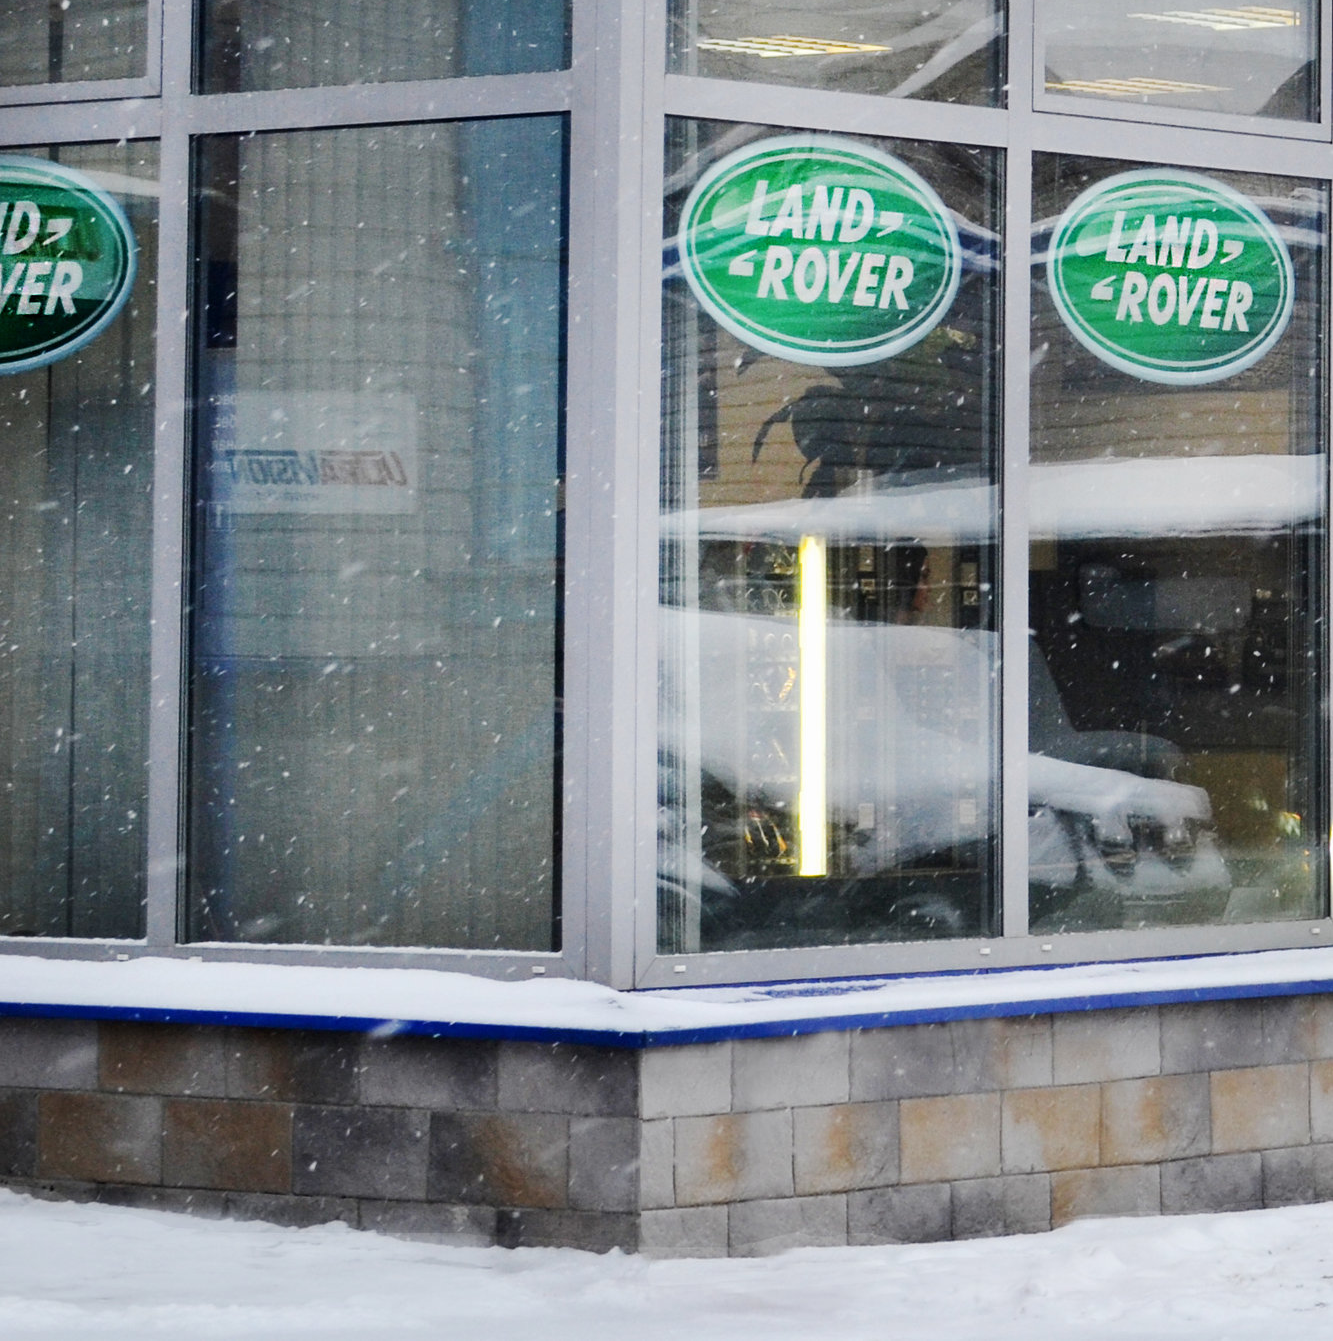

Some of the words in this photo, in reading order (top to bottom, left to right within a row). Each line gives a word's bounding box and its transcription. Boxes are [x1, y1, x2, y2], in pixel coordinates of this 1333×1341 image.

[745, 180, 875, 242] LAND
[1106, 210, 1216, 270] LAND
[757, 246, 914, 310] ROVER
[1115, 272, 1253, 332] ROVER
